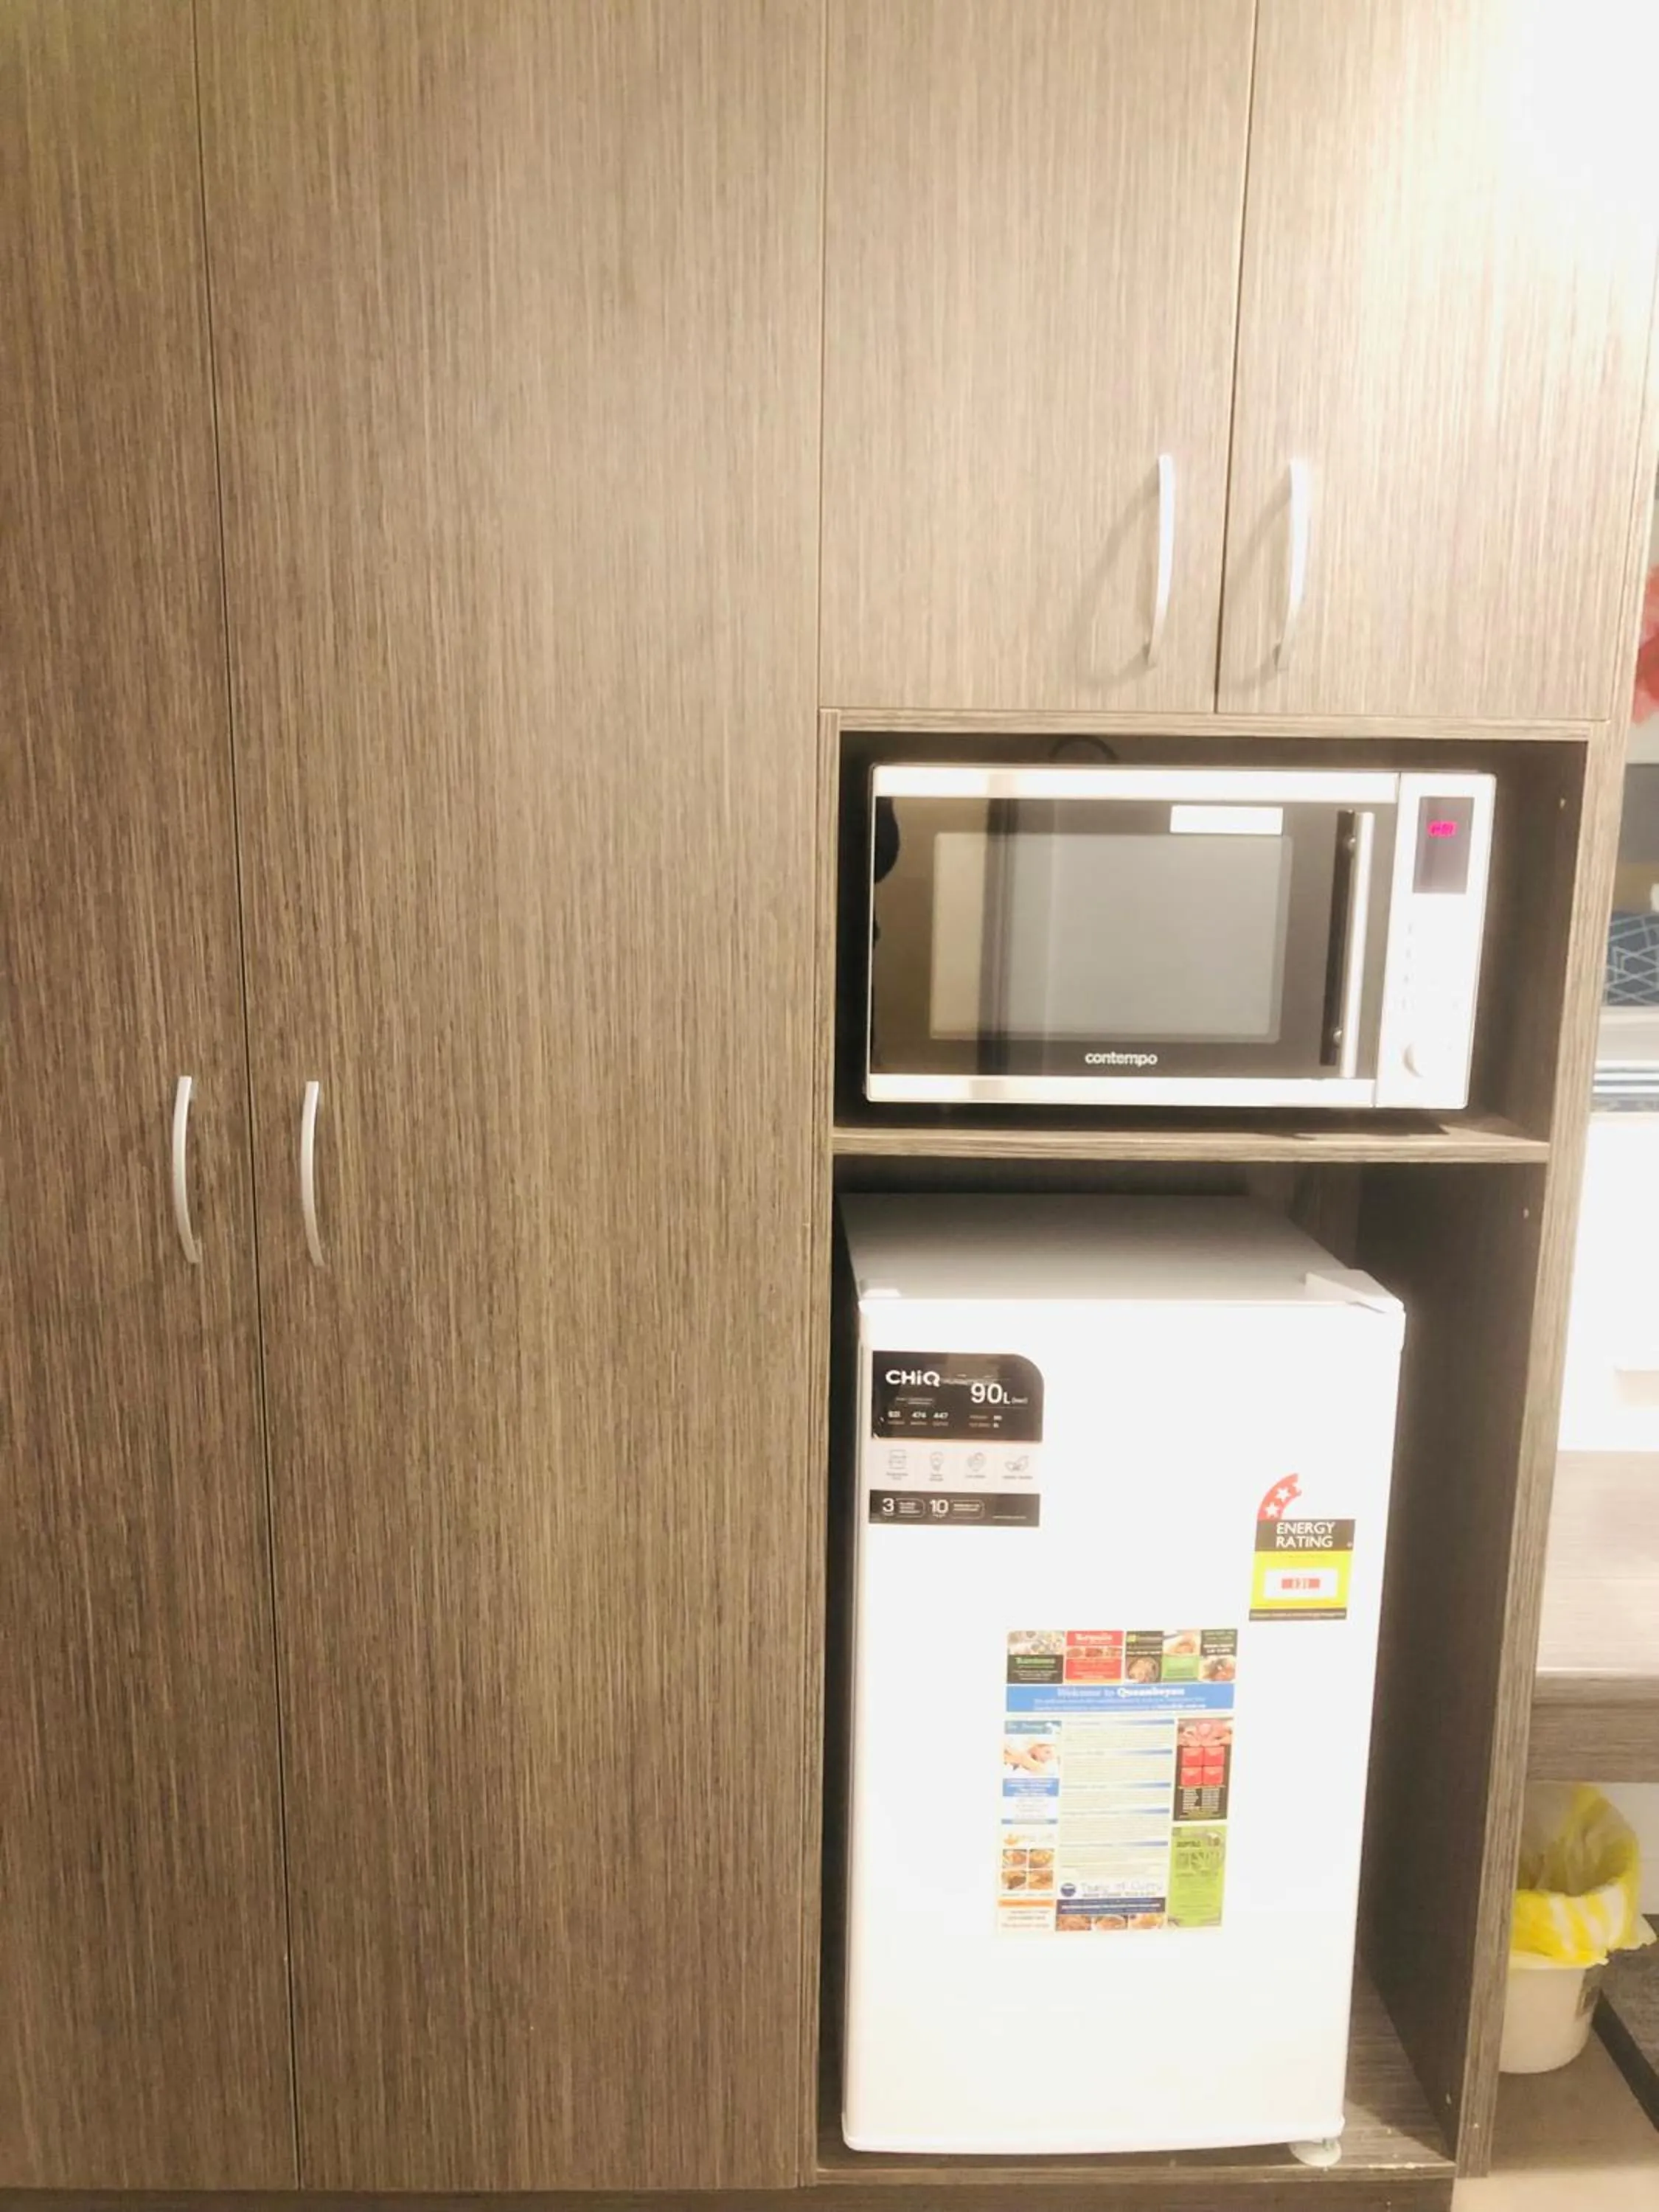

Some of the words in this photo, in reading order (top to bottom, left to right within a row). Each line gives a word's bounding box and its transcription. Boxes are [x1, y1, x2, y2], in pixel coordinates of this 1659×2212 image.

[1085, 1051, 1158, 1067] contempo
[886, 1370, 940, 1387] CHiQ
[883, 1498, 894, 1512] 3
[930, 1499, 949, 1514] 10
[1276, 1522, 1335, 1534] ENERGY
[1276, 1536, 1333, 1548] RATING
